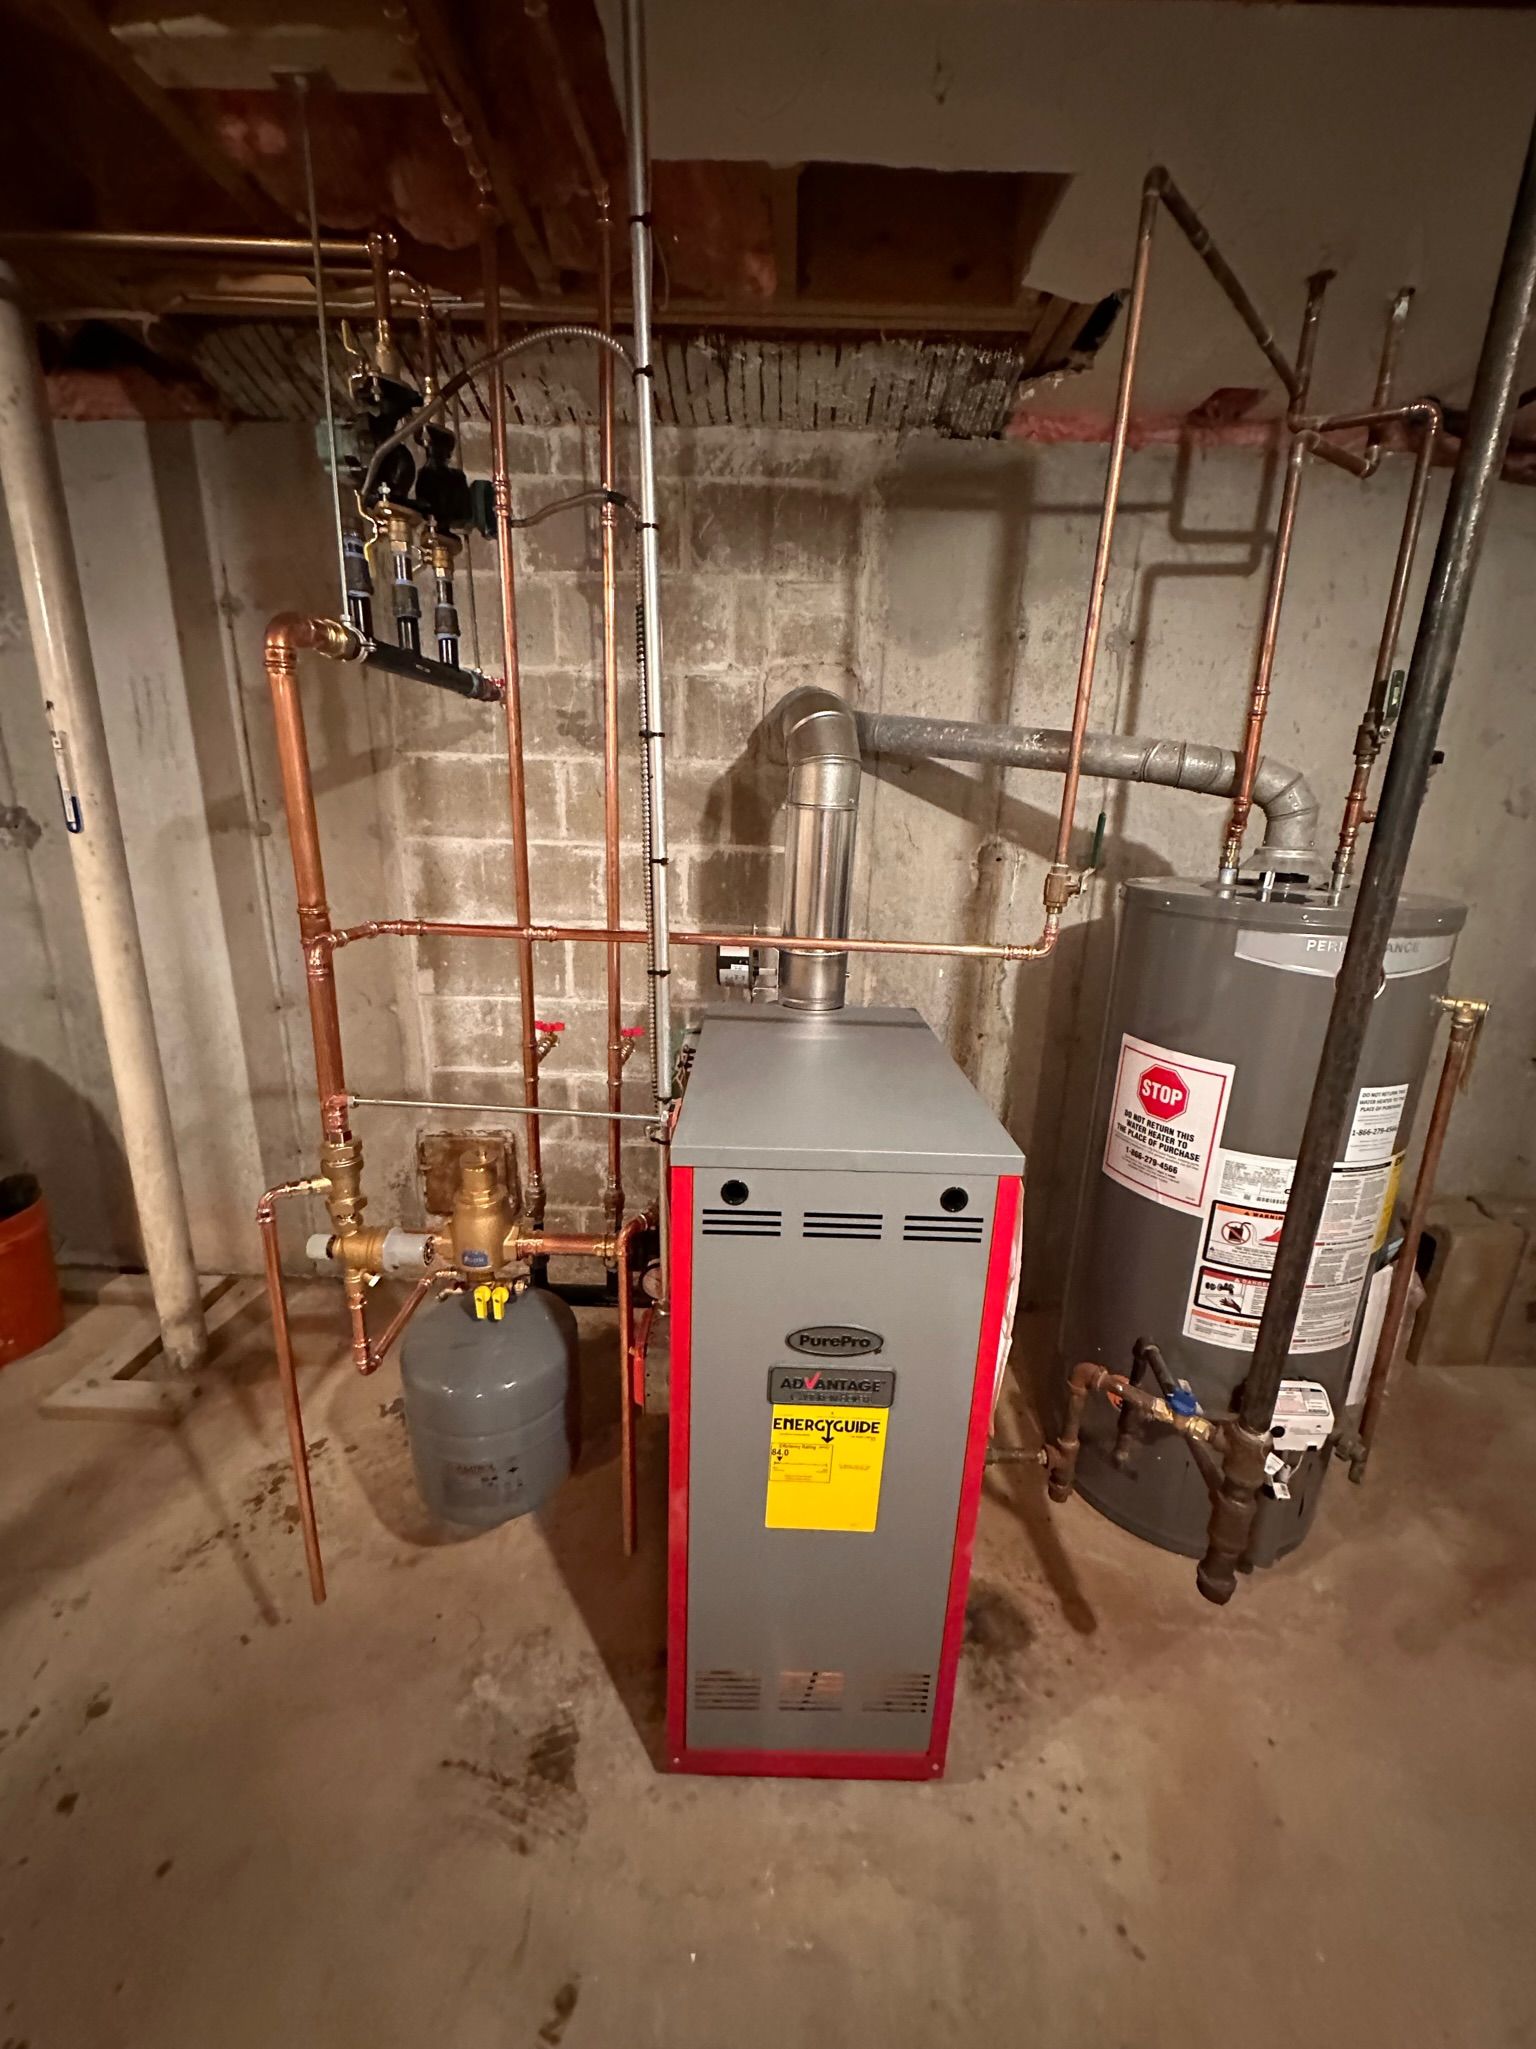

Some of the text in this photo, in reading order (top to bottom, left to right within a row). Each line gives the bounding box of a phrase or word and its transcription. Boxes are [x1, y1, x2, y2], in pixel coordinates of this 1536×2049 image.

[1142, 1079, 1183, 1106] STOP
[1124, 1109, 1195, 1142] DO NOT RETURN THIS
[1126, 1119, 1188, 1149] WATER HEATER TO
[1117, 1122, 1201, 1163] THE PLACE OF PURCHASE
[1126, 1146, 1178, 1175] 1-866-279-4566
[1252, 1212, 1284, 1221] WARNIN
[799, 1334, 871, 1348] PurePro
[780, 1371, 881, 1392] ADVANTAGE
[773, 1417, 881, 1441] ENERGYGUIDE
[771, 1448, 789, 1457] 84.0
